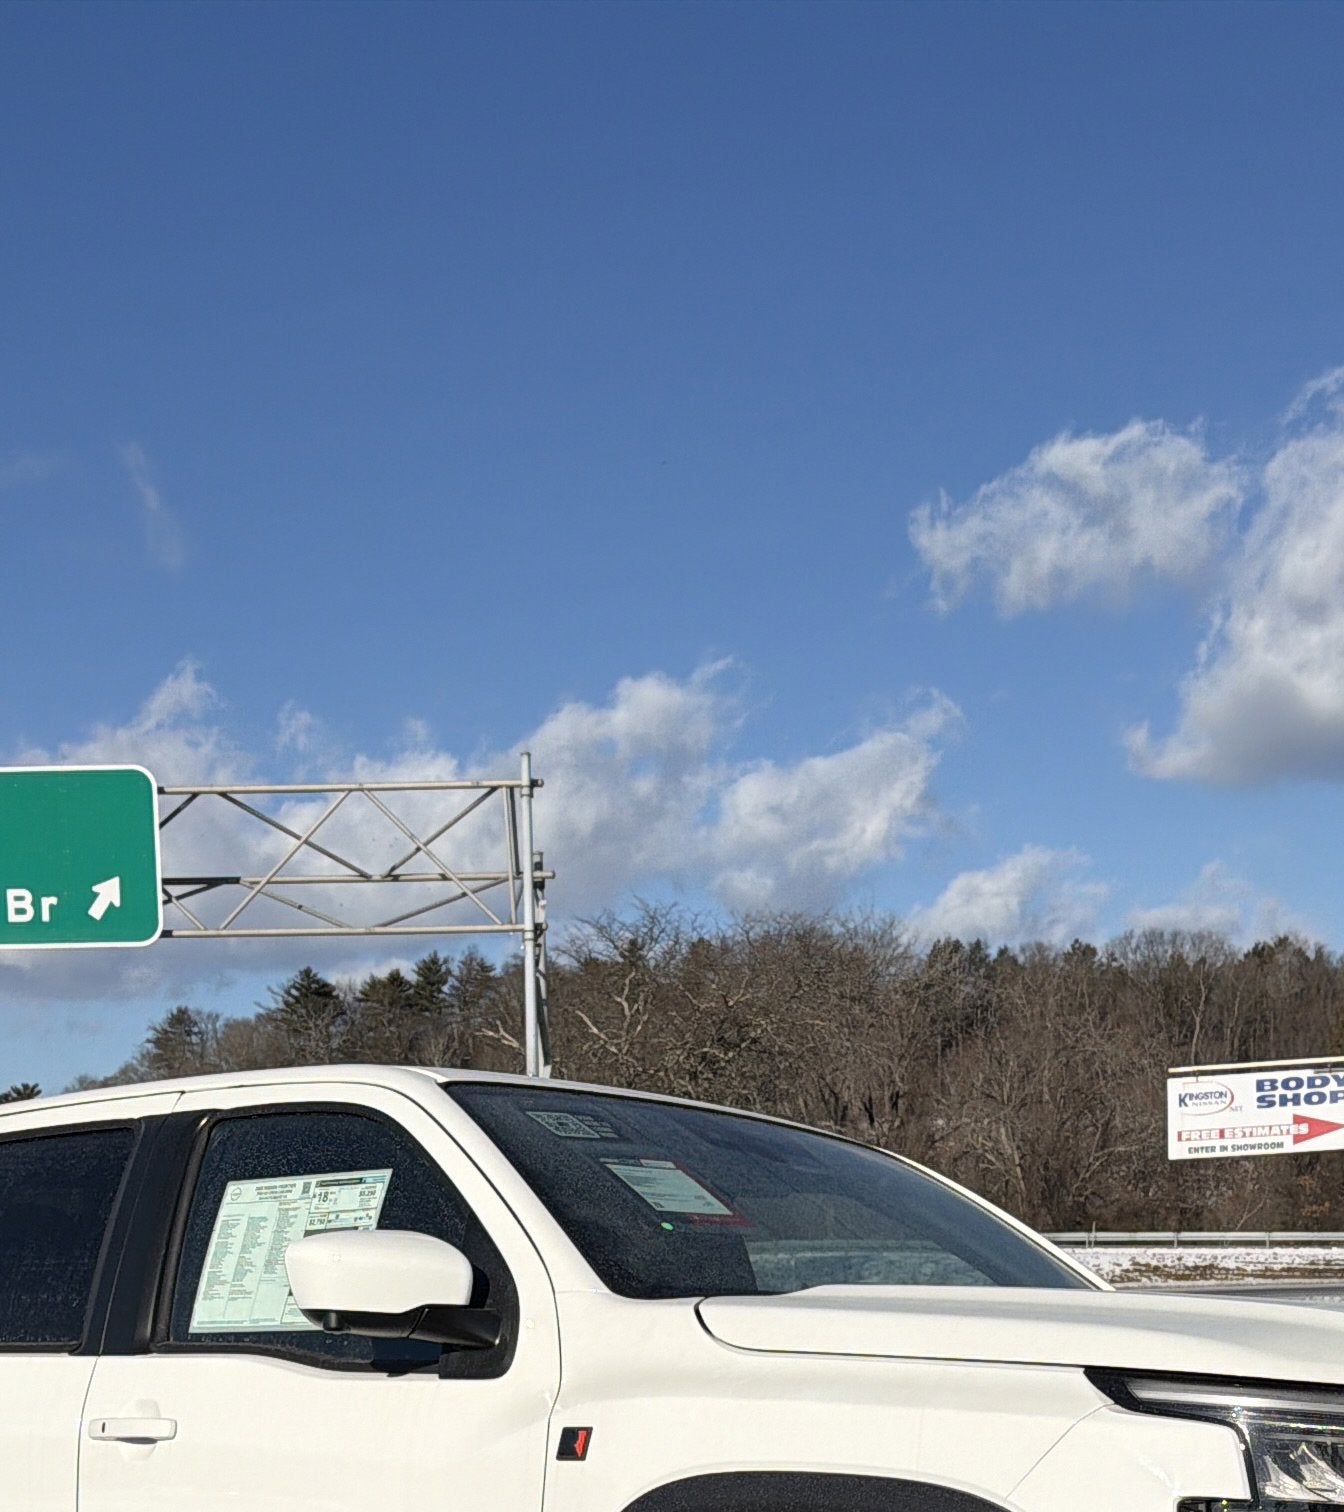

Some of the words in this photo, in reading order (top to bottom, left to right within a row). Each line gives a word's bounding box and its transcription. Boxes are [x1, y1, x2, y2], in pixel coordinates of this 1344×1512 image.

[5, 888, 58, 923] Br
[1178, 1090, 1228, 1108] KINGSTON
[1181, 1129, 1220, 1141] FREE
[1224, 1122, 1309, 1139] ESTIMATES
[1188, 1145, 1216, 1154] ENTER
[1219, 1144, 1228, 1152] IN
[1230, 1141, 1284, 1152] SHOWROOM
